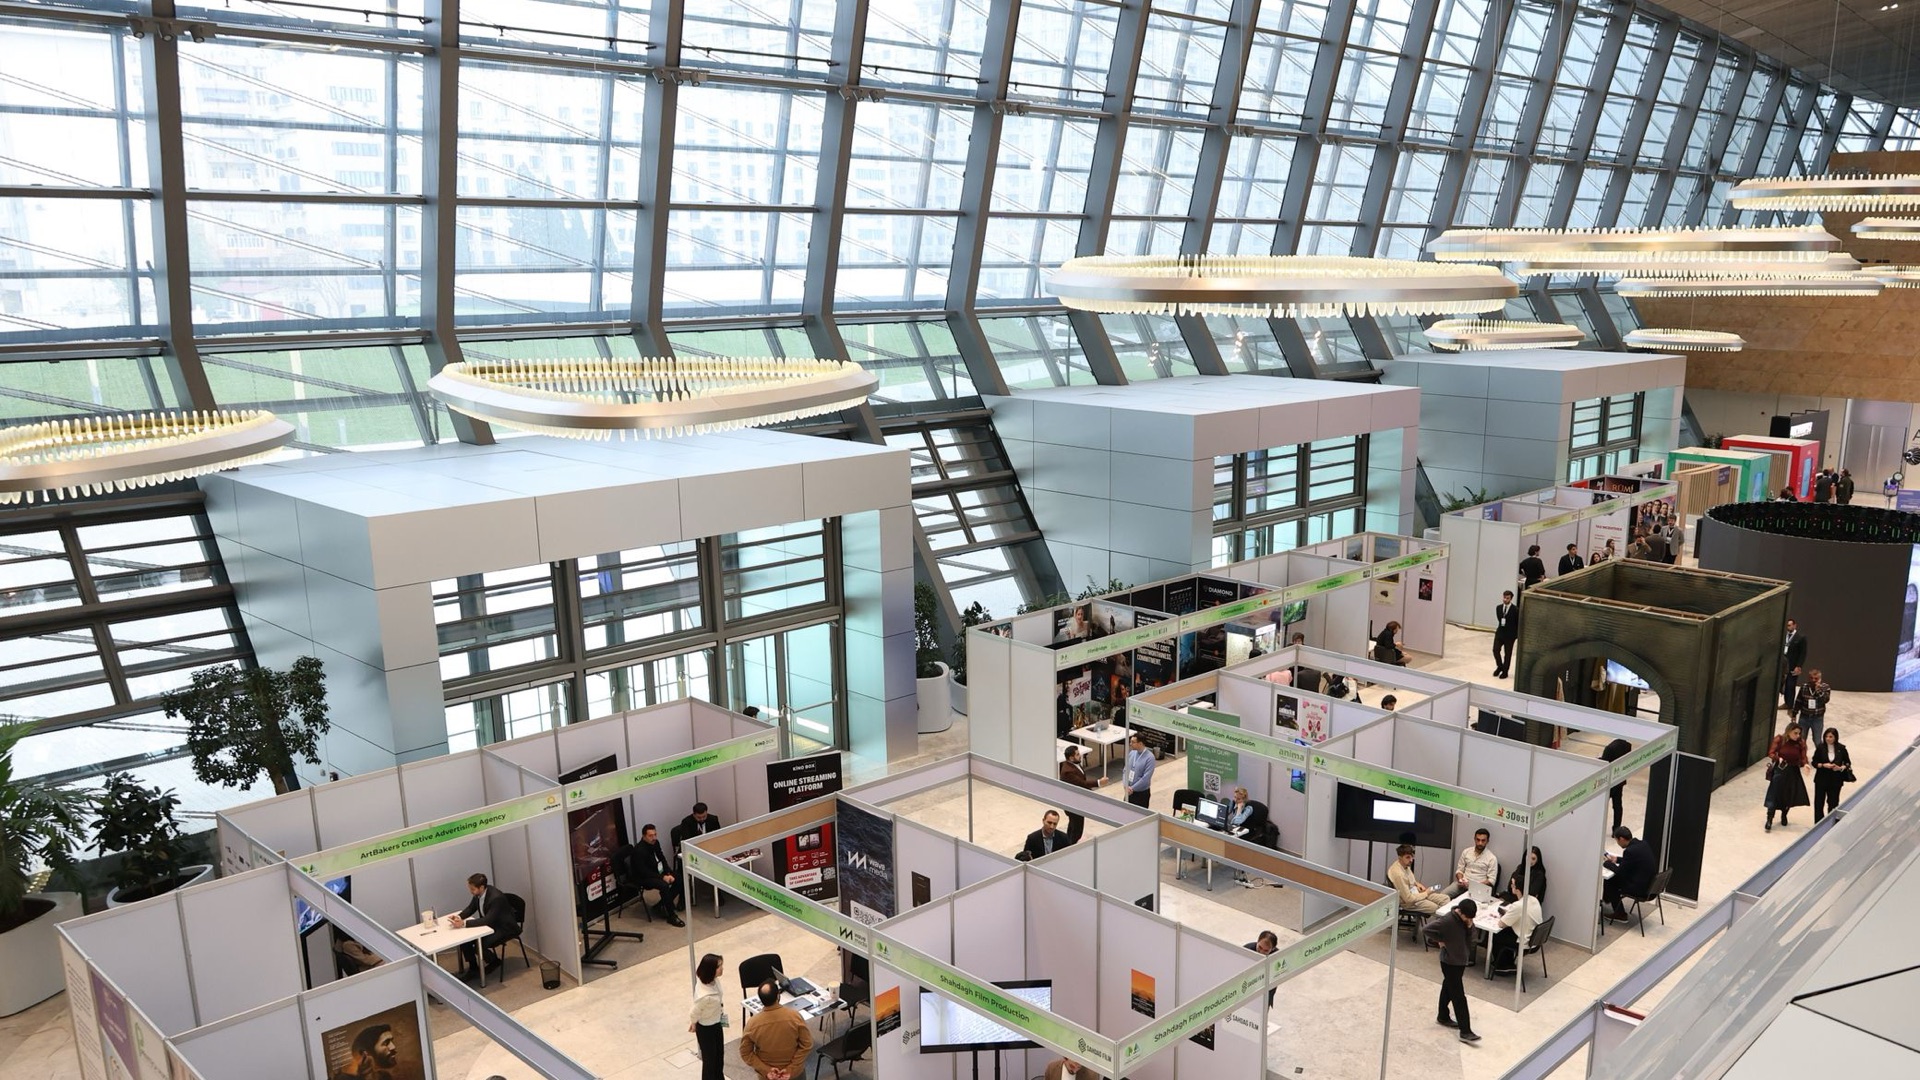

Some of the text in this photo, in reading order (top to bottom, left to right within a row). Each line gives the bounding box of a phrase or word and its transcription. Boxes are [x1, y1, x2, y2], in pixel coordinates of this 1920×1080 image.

[1208, 586, 1234, 596] DIAMOND
[1172, 719, 1305, 762] Azerbaijan Animation Association anima
[634, 770, 660, 782] Kinobox
[660, 761, 692, 776] Streaming
[693, 754, 718, 768] Platform
[774, 772, 836, 789] ONLINE STREAMING
[788, 782, 823, 794] PLATFORM
[1388, 779, 1529, 824] 3Dost Animation 3Dost
[360, 843, 401, 859] ArtBakers
[401, 833, 434, 848] Creative
[434, 821, 478, 839] Advertising
[478, 812, 507, 827] Agency
[869, 860, 886, 871] wave
[869, 867, 888, 880] media
[741, 880, 803, 915] Wave Media Production
[1304, 921, 1367, 957] Chinar Film Production
[940, 974, 974, 996] Shahdagh
[974, 990, 990, 1004] Film
[991, 998, 1030, 1023] Production
[1102, 1052, 1112, 1062] FILM
[1154, 1017, 1188, 1042] Shahdagh
[1188, 1011, 1203, 1024] Film
[1203, 990, 1237, 1014] Production
[1249, 1020, 1259, 1030] FILM
